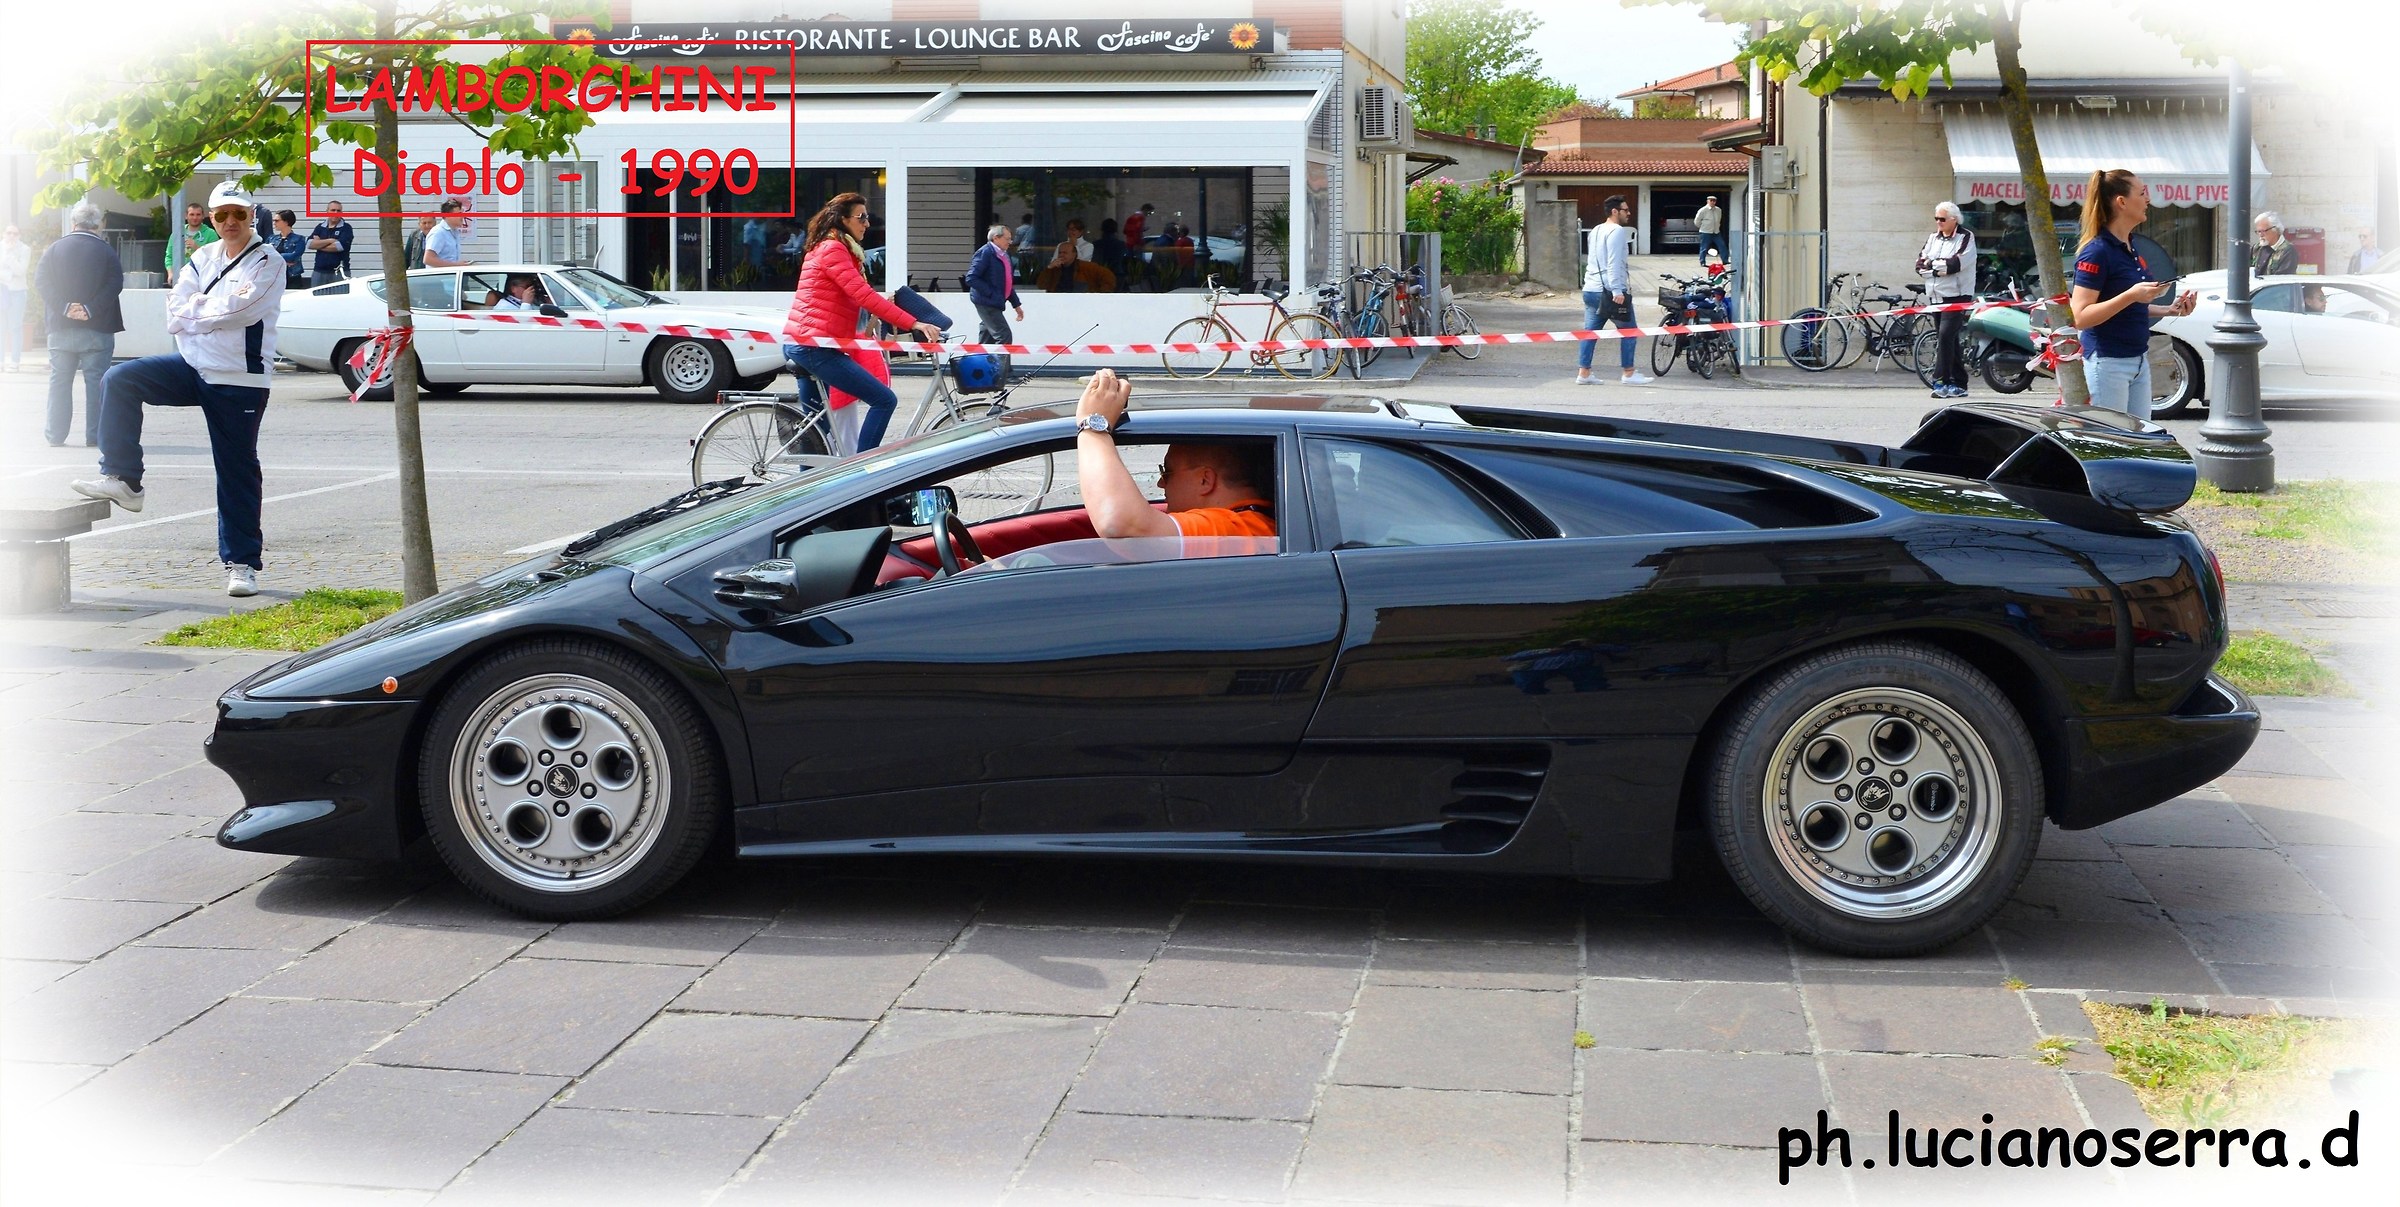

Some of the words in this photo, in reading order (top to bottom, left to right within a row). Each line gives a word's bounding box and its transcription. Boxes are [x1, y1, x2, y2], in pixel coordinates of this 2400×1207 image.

[735, 29, 893, 50] RISTORANTE
[915, 27, 1021, 49] LOUNGE
[1028, 26, 1081, 48] BAR
[1097, 21, 1171, 51] Fascino
